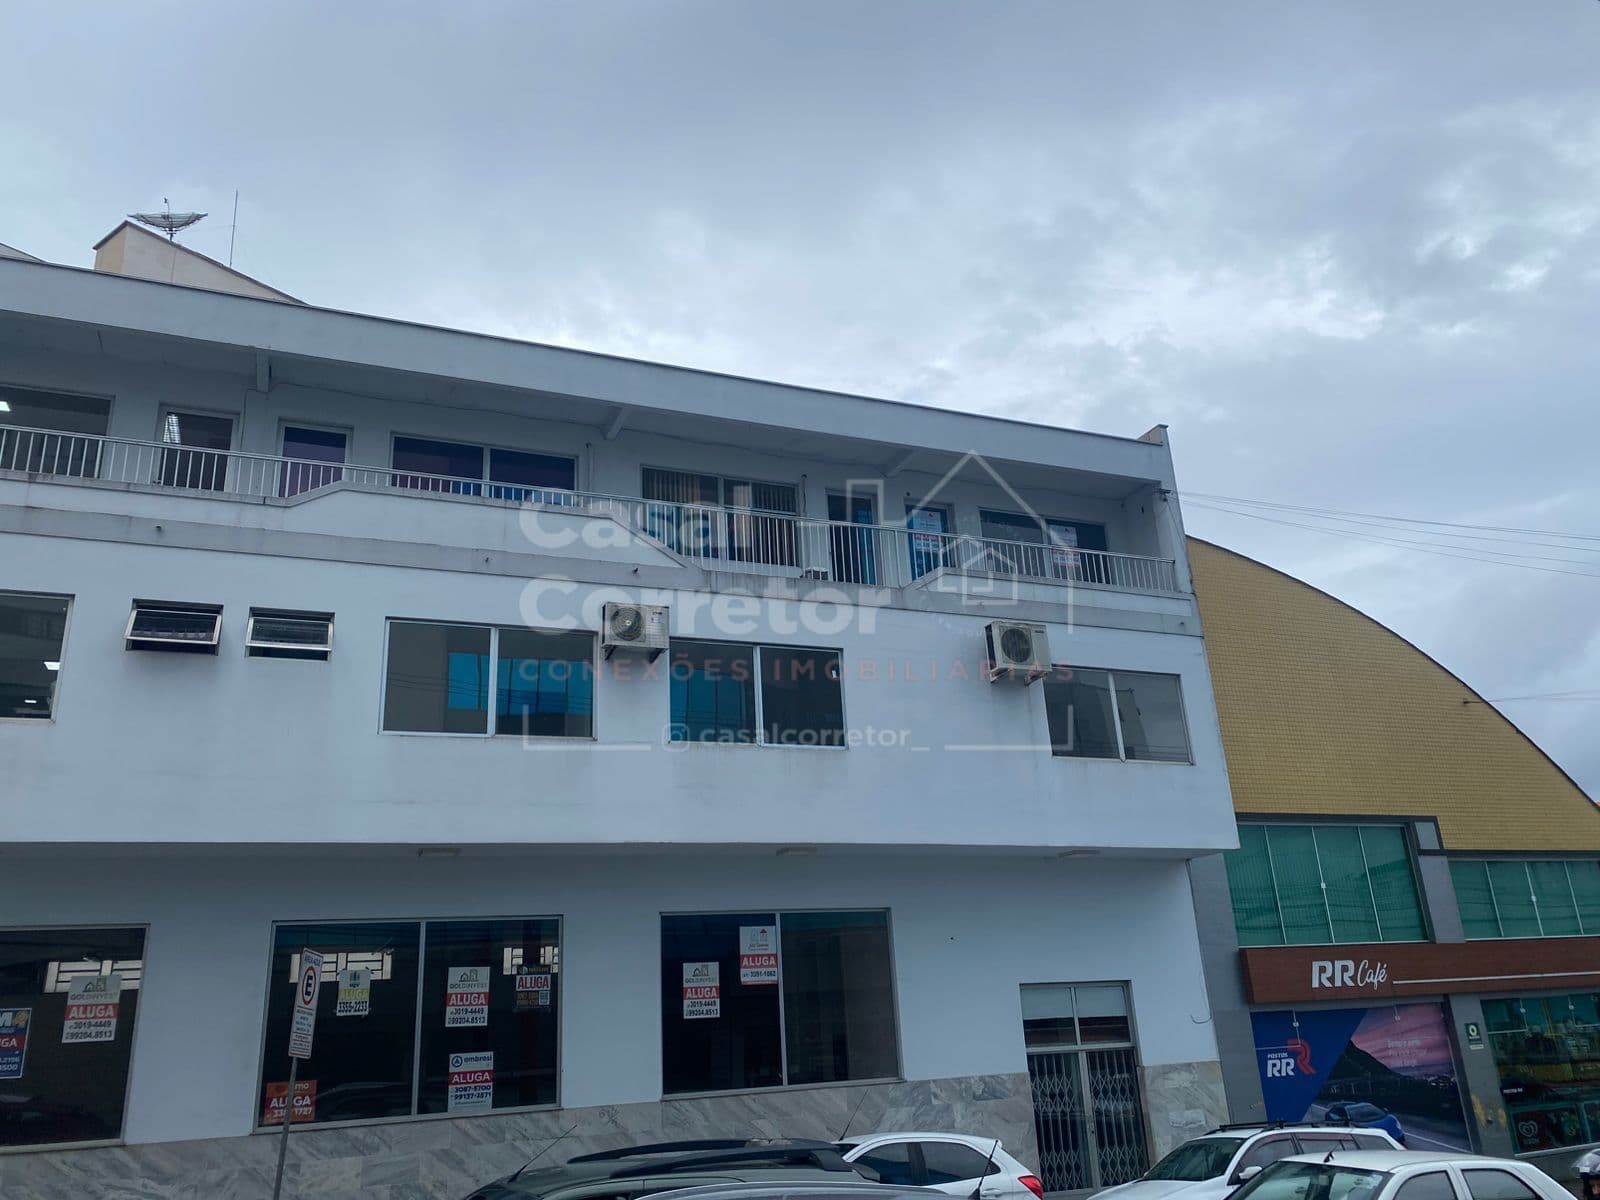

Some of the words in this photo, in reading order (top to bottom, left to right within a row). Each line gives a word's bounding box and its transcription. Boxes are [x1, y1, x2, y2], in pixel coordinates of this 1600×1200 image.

[742, 956, 776, 967] ALUGA
[1312, 959, 1355, 988] RR
[1357, 959, 1387, 990] Café
[304, 975, 313, 996] E
[518, 976, 549, 989] ALUGA
[339, 988, 368, 1000] ALUGA
[686, 987, 717, 998] ALUGA
[448, 993, 486, 1006] ALUGA
[69, 1005, 114, 1018] ALUGA
[454, 1007, 484, 1015] 3019-4449
[74, 1020, 112, 1029] 3019-4449
[1267, 1058, 1295, 1078] RR
[452, 1072, 490, 1084] ALUGA
